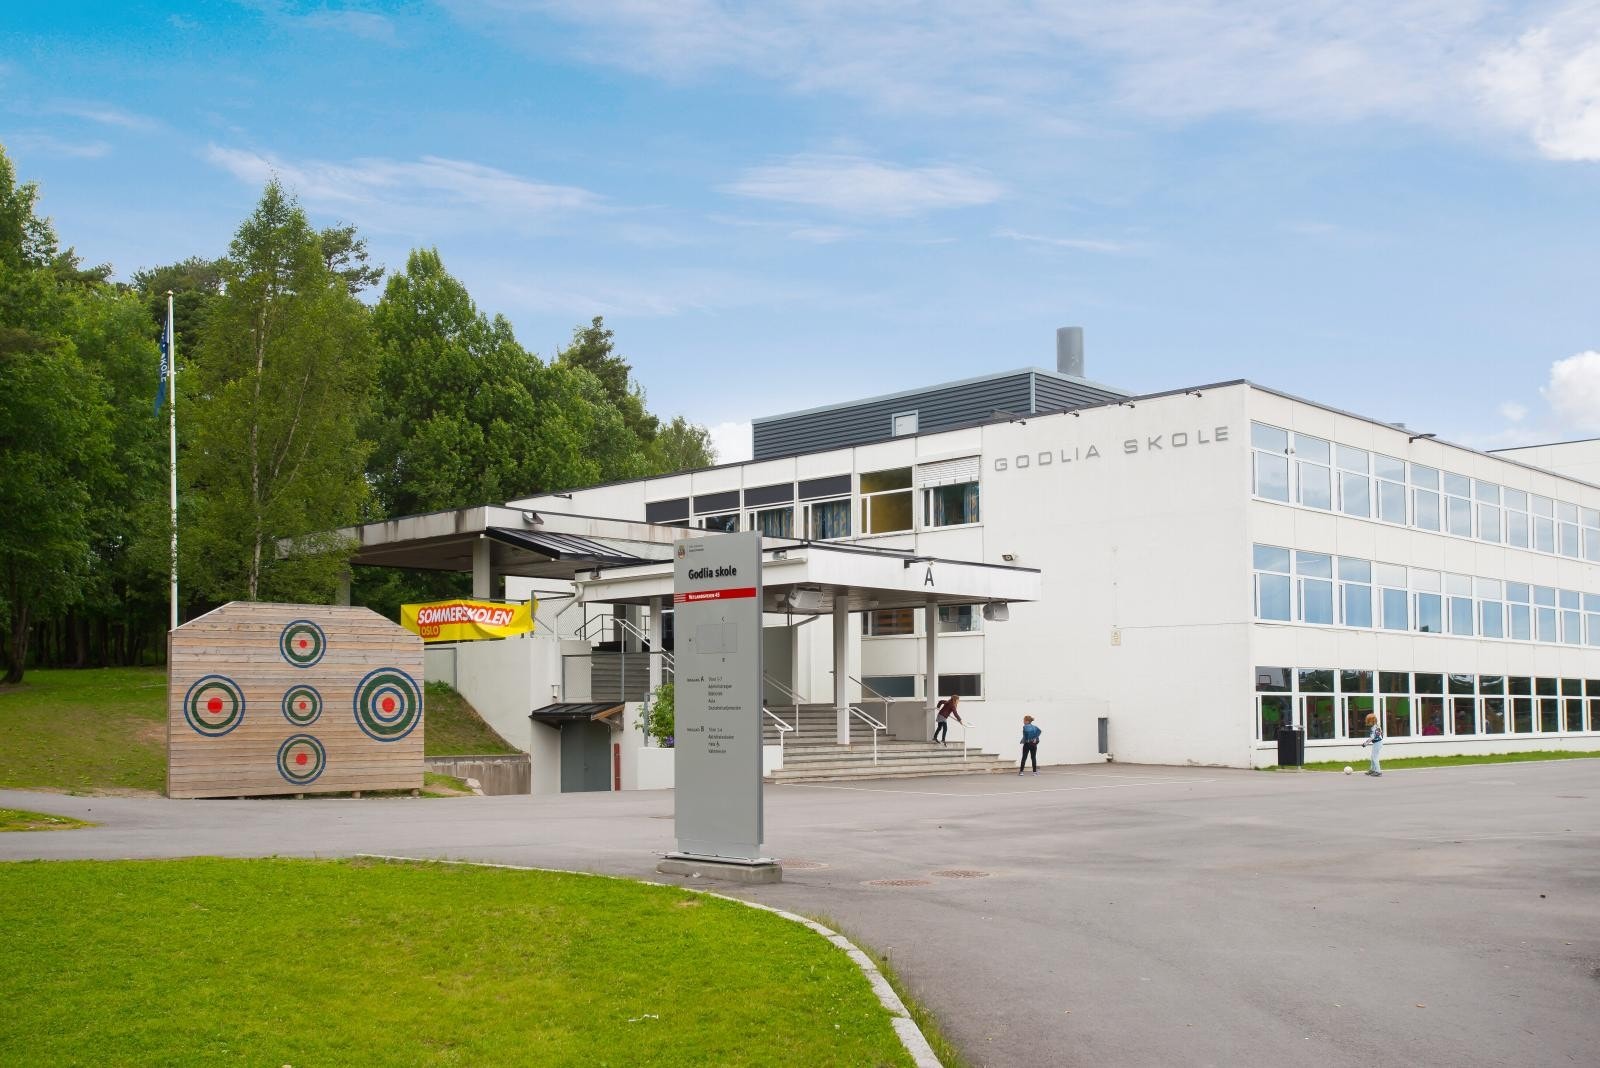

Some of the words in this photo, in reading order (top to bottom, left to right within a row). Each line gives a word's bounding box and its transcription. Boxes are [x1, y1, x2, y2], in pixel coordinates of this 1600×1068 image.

[994, 444, 1101, 472] GODLIA
[1123, 425, 1230, 454] SKOLE
[688, 567, 714, 580] Godlia
[715, 565, 737, 577] skole
[924, 567, 935, 587] A
[418, 605, 513, 625] SOMMERSKOLEN
[421, 626, 439, 636] OSLO
